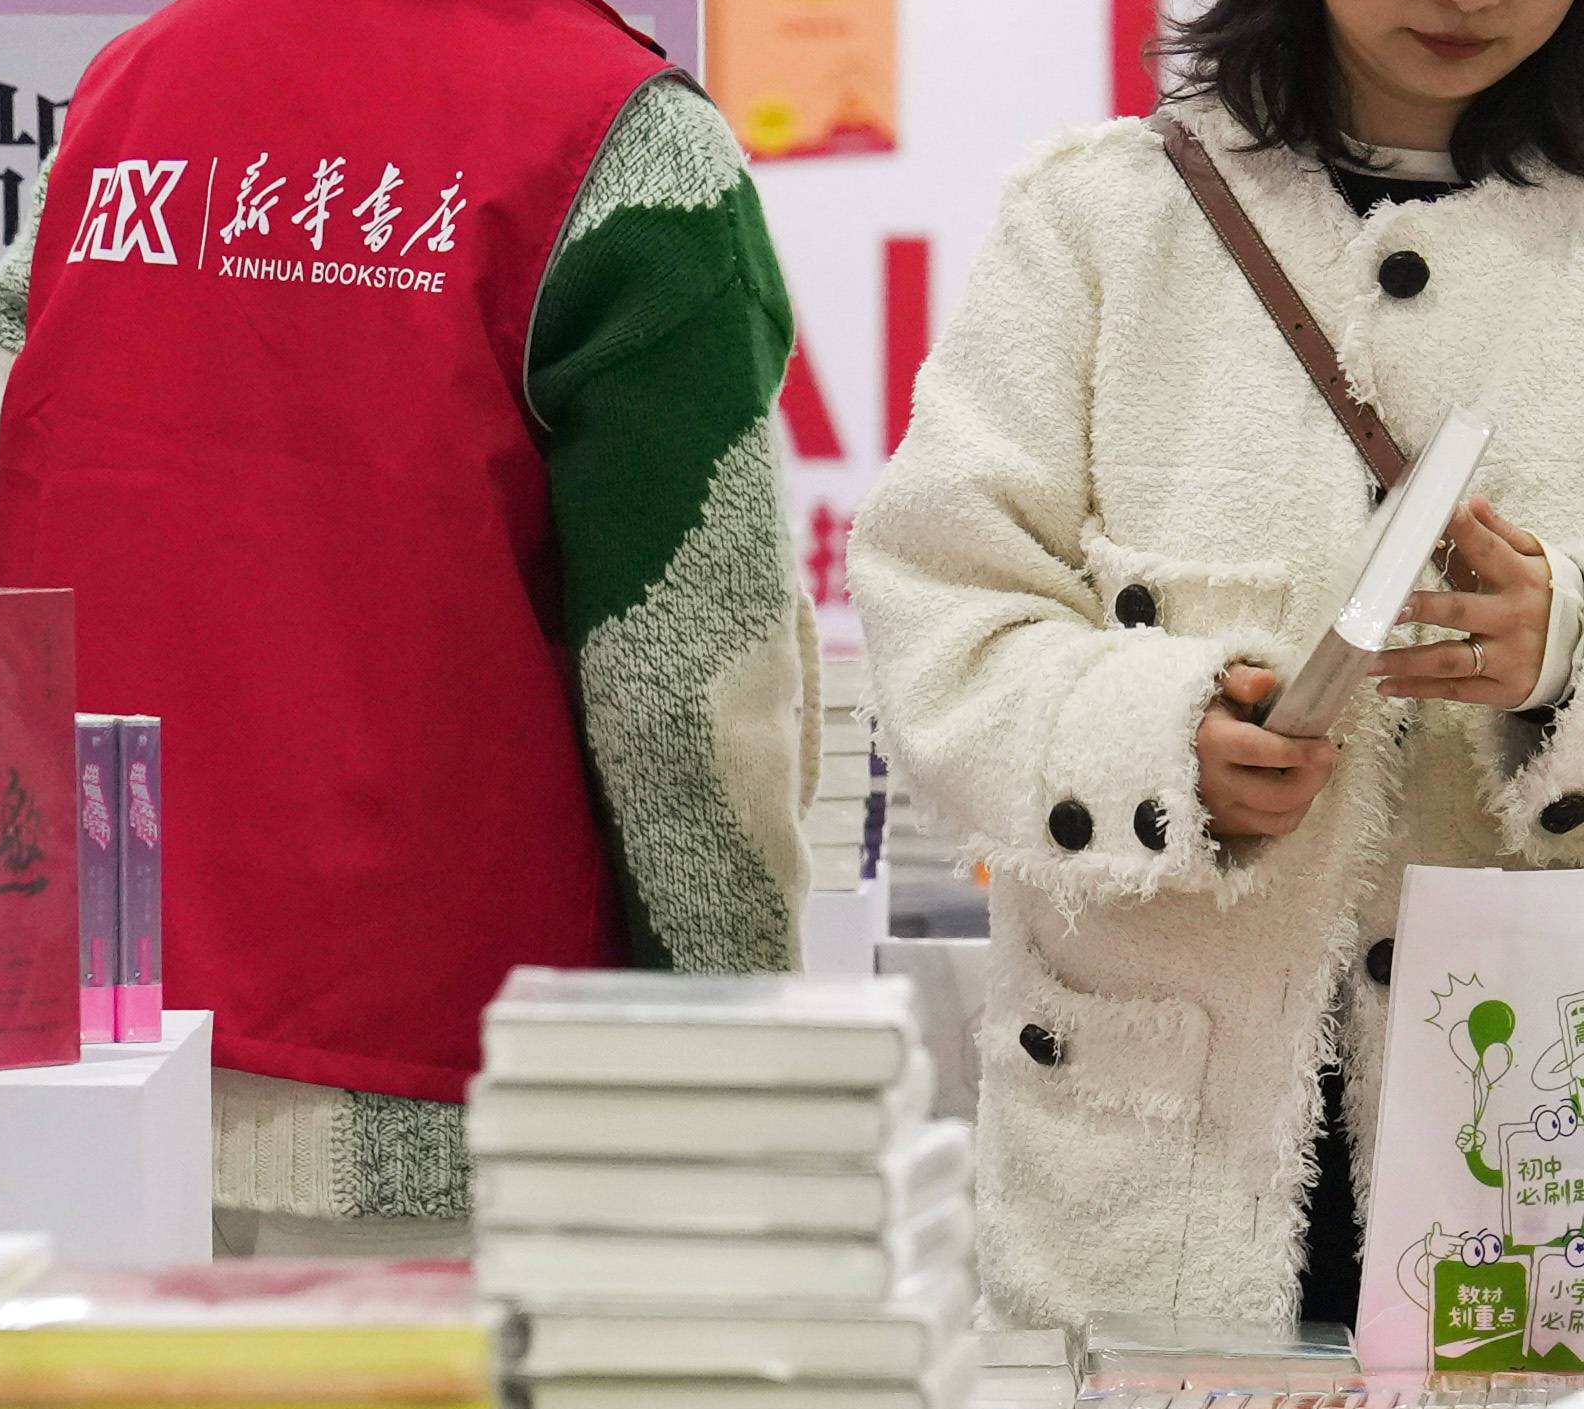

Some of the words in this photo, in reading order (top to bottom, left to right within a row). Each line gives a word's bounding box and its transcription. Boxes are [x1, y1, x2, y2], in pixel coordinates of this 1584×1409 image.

[219, 256, 304, 282] XINHUA
[312, 262, 446, 293] BOOKSTORE
[1517, 1155, 1562, 1182] 初中
[1457, 1283, 1504, 1305] 教材
[1448, 1305, 1517, 1331] 划重点
